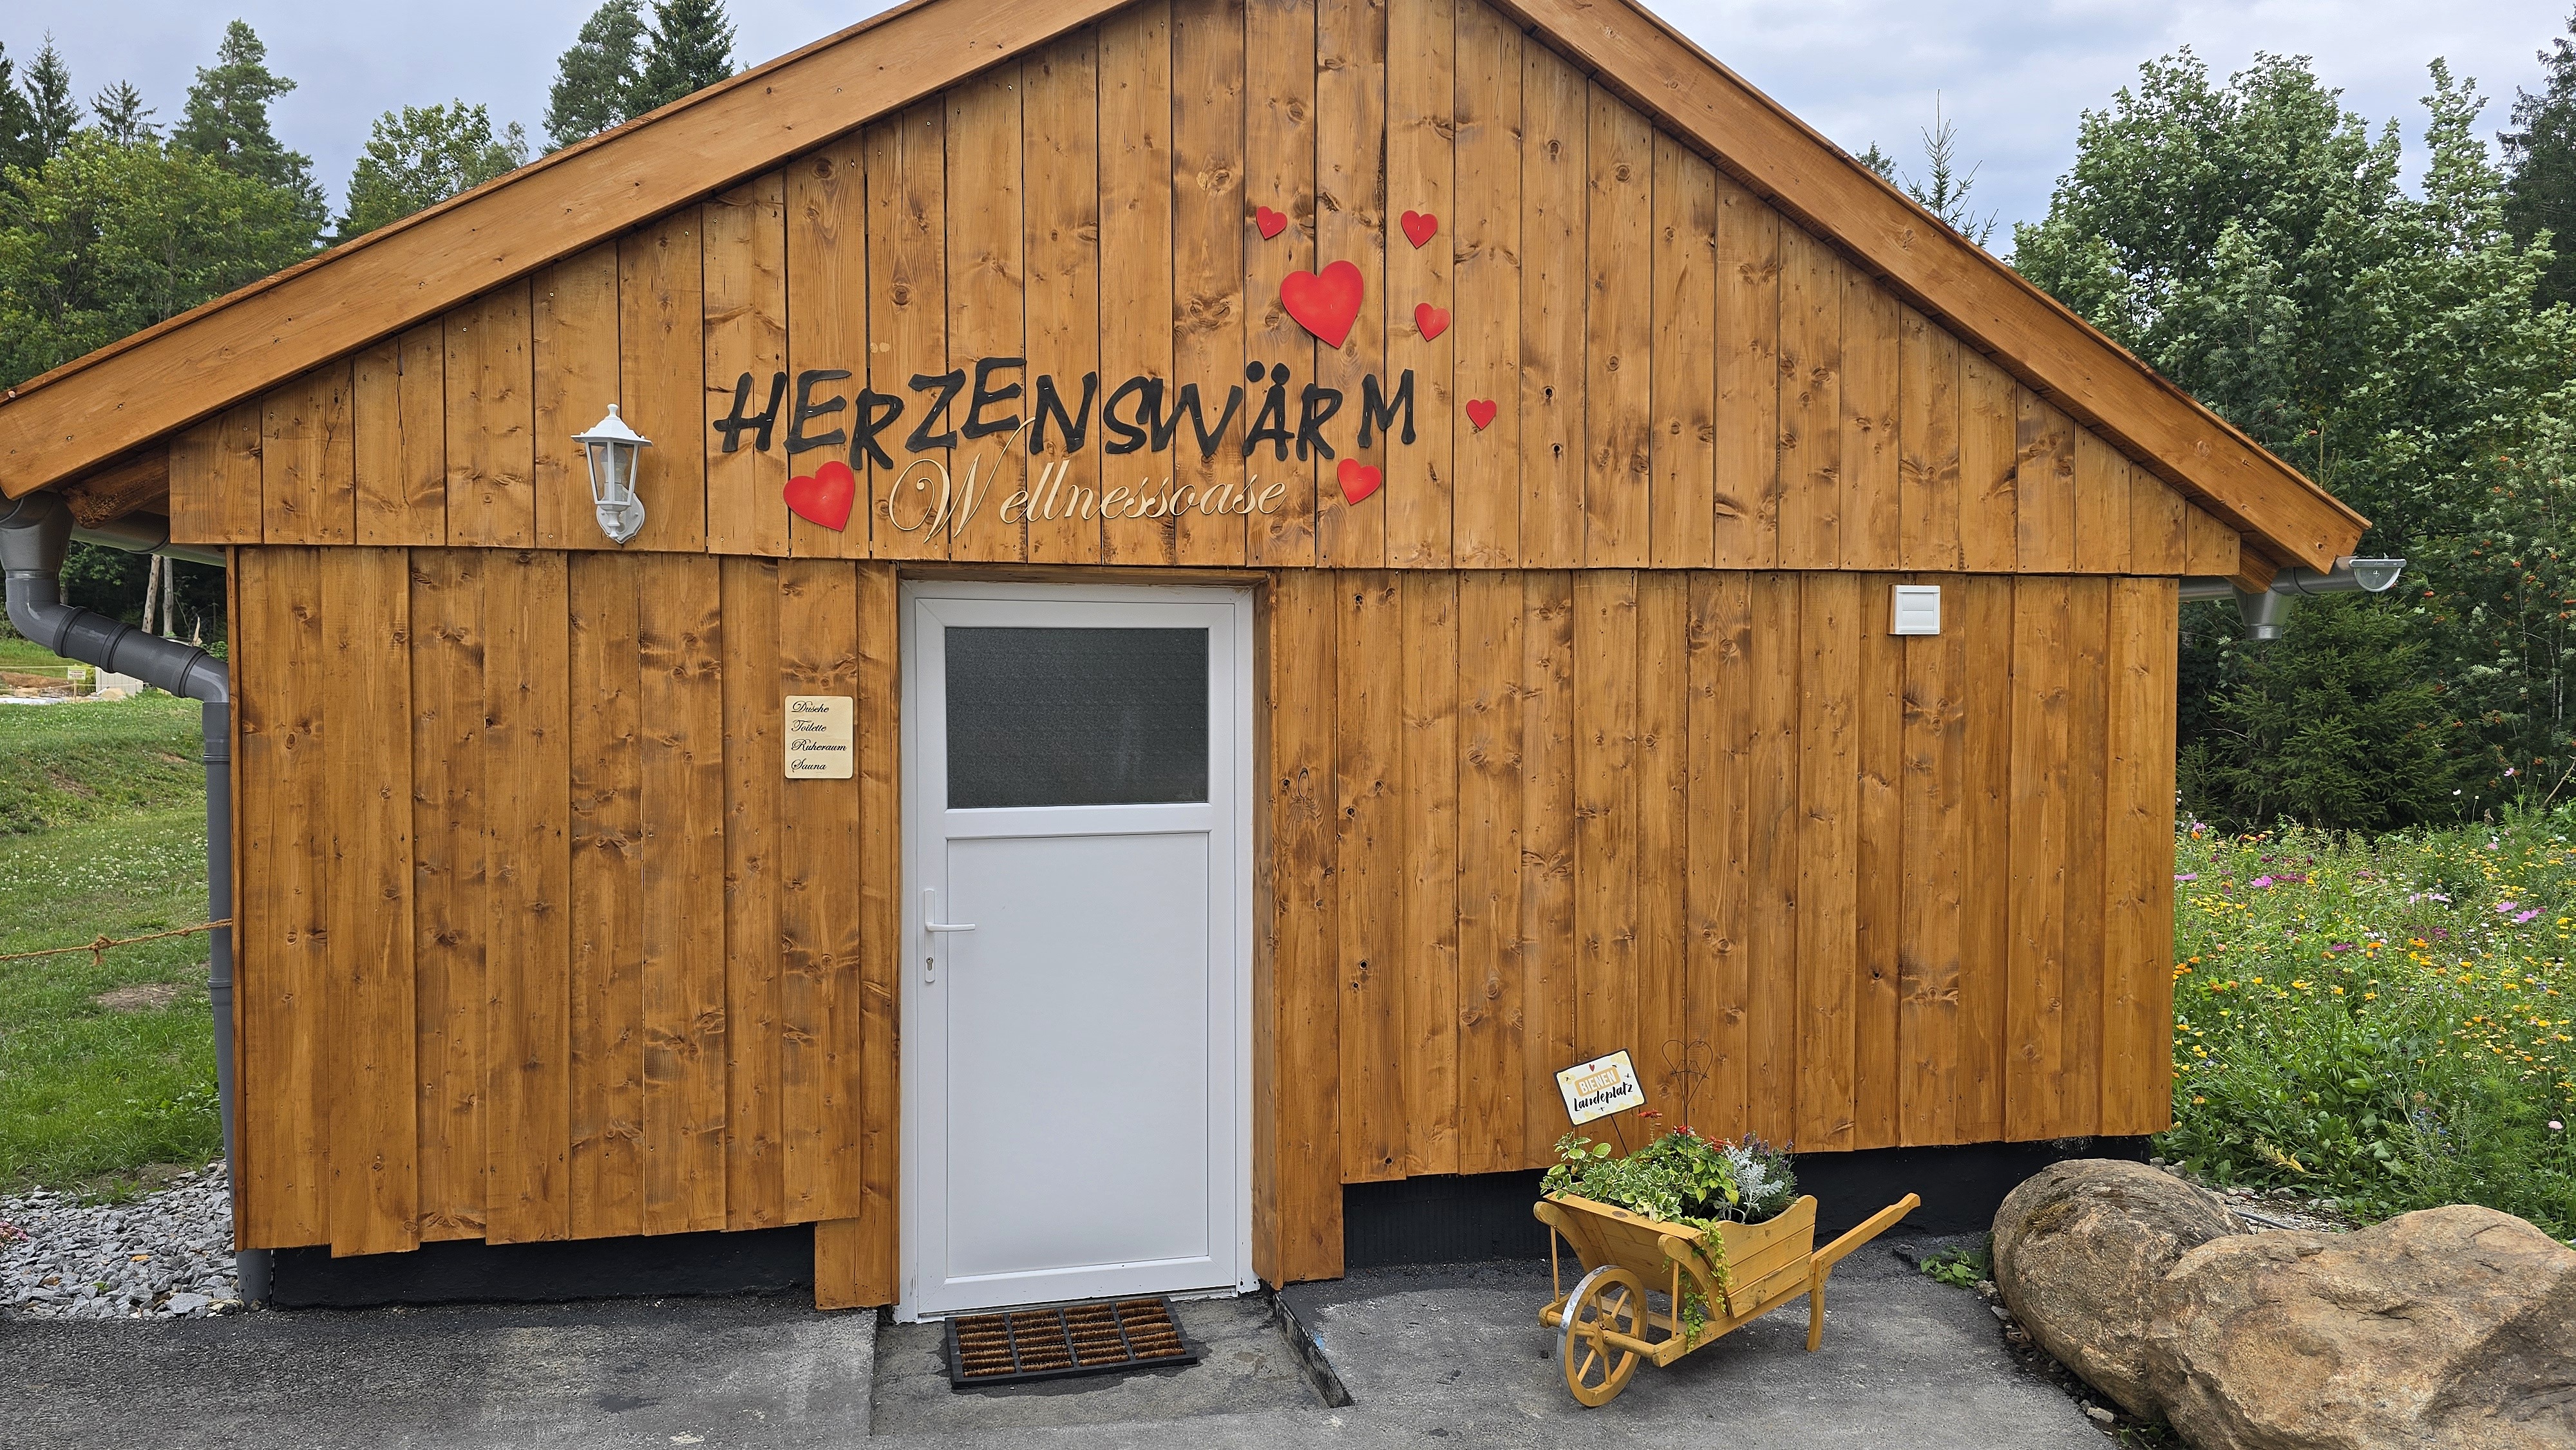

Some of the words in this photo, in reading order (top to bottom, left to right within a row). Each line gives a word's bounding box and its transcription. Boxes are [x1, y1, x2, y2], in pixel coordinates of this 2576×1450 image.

[713, 357, 1416, 470] HERZENSWÄRM
[889, 416, 1287, 543] Wellnessoase
[791, 700, 829, 713] Dusche
[791, 719, 827, 732] Toilette
[791, 739, 847, 751] Ruheraum
[791, 758, 827, 773] Sauna
[1578, 1069, 1617, 1095] BIENEN
[1573, 1082, 1634, 1112] Landeplatz
